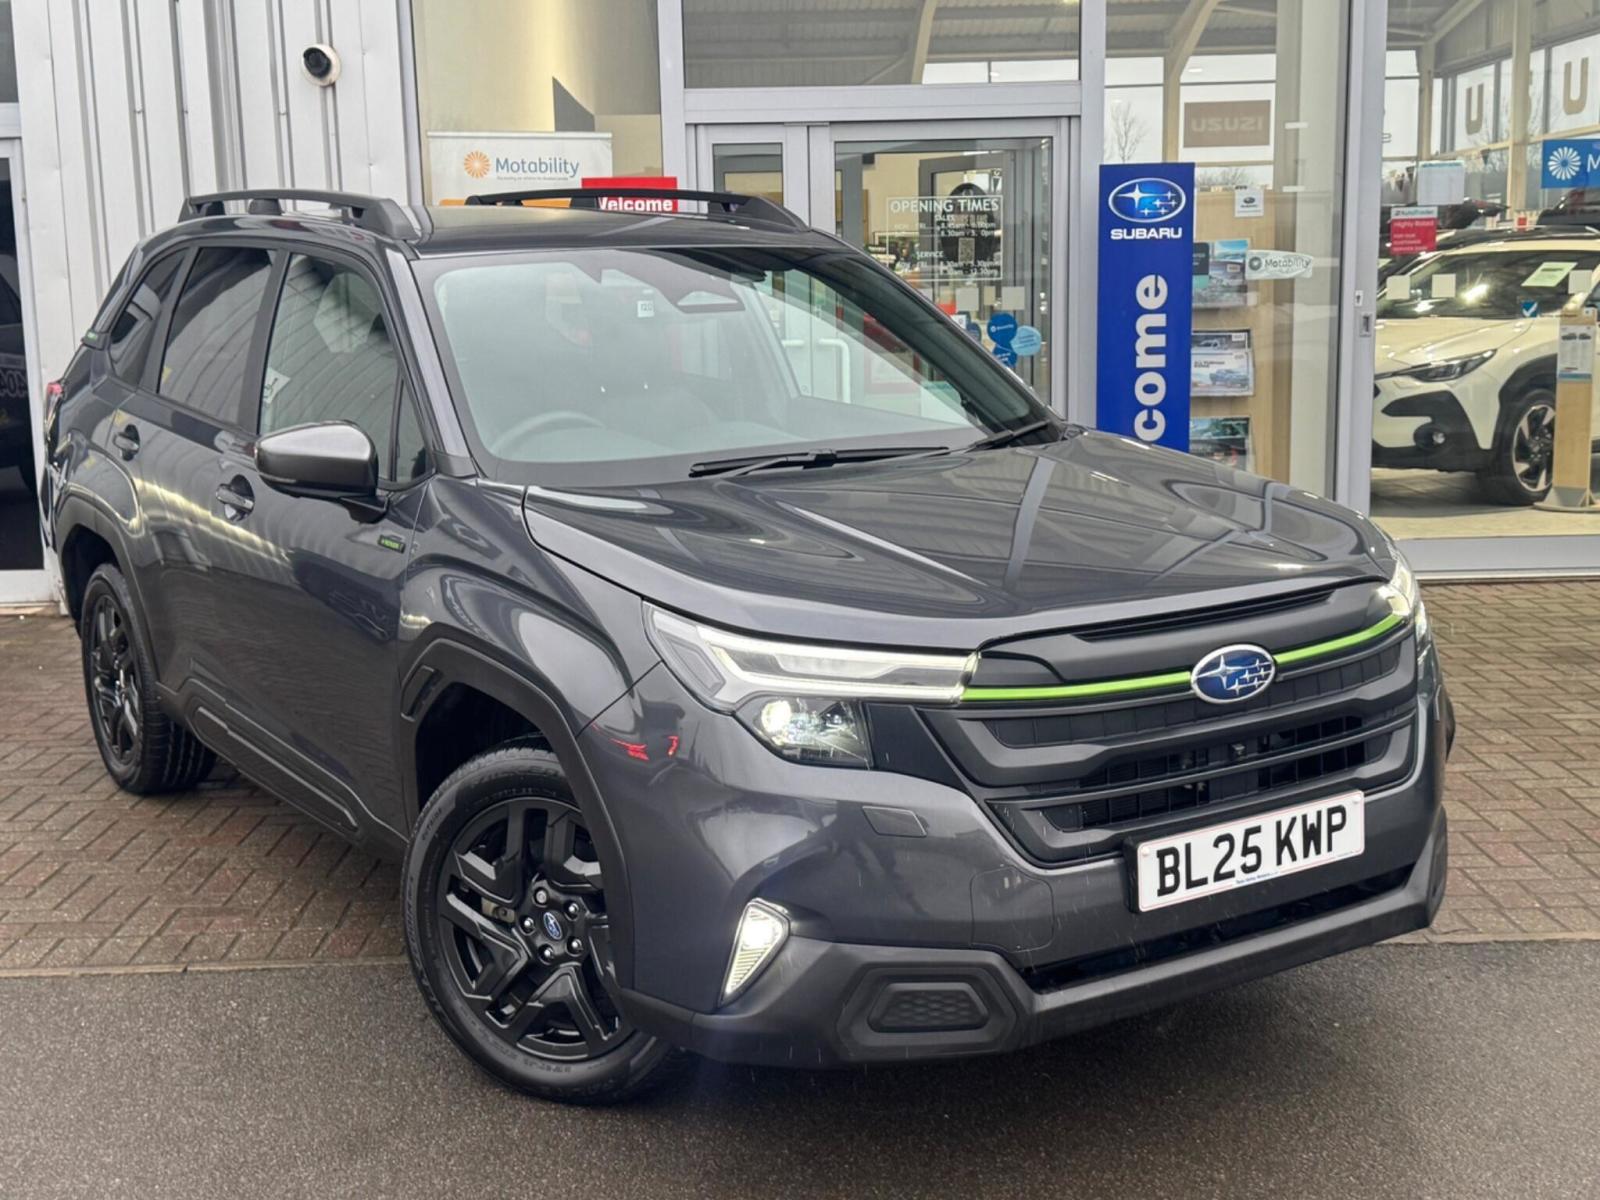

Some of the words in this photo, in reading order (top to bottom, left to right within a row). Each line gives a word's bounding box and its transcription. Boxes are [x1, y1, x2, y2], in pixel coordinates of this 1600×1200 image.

[495, 157, 580, 178] Motability
[889, 199, 954, 213] OPENING
[958, 198, 999, 212] TIMES
[1110, 227, 1182, 240] SUBARU
[1264, 257, 1312, 270] Motability
[1134, 274, 1168, 442] come
[1156, 825, 1263, 897] BL25
[1275, 804, 1347, 867] KWP
